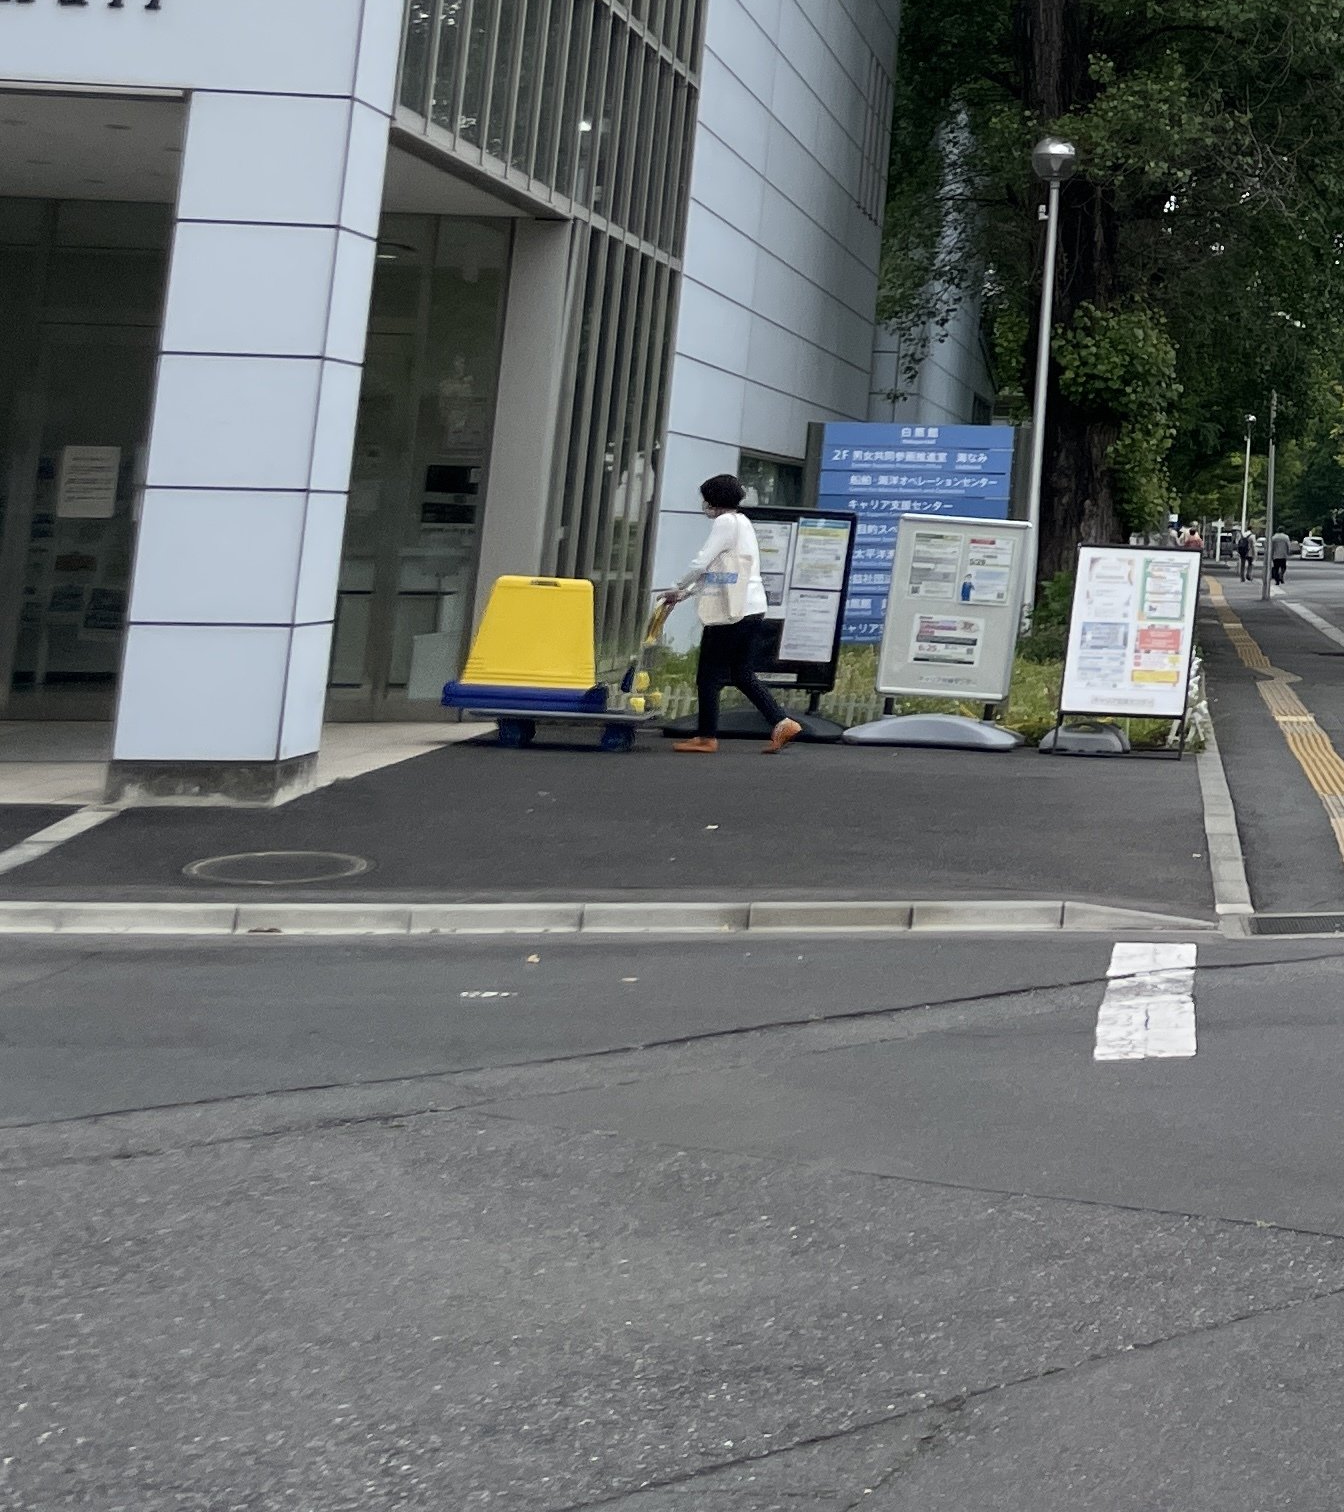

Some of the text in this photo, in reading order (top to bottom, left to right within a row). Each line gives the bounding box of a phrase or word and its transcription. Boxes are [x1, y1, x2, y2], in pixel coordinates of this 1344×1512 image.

[832, 449, 849, 461] 2F
[848, 499, 954, 511] キャリア支援センター
